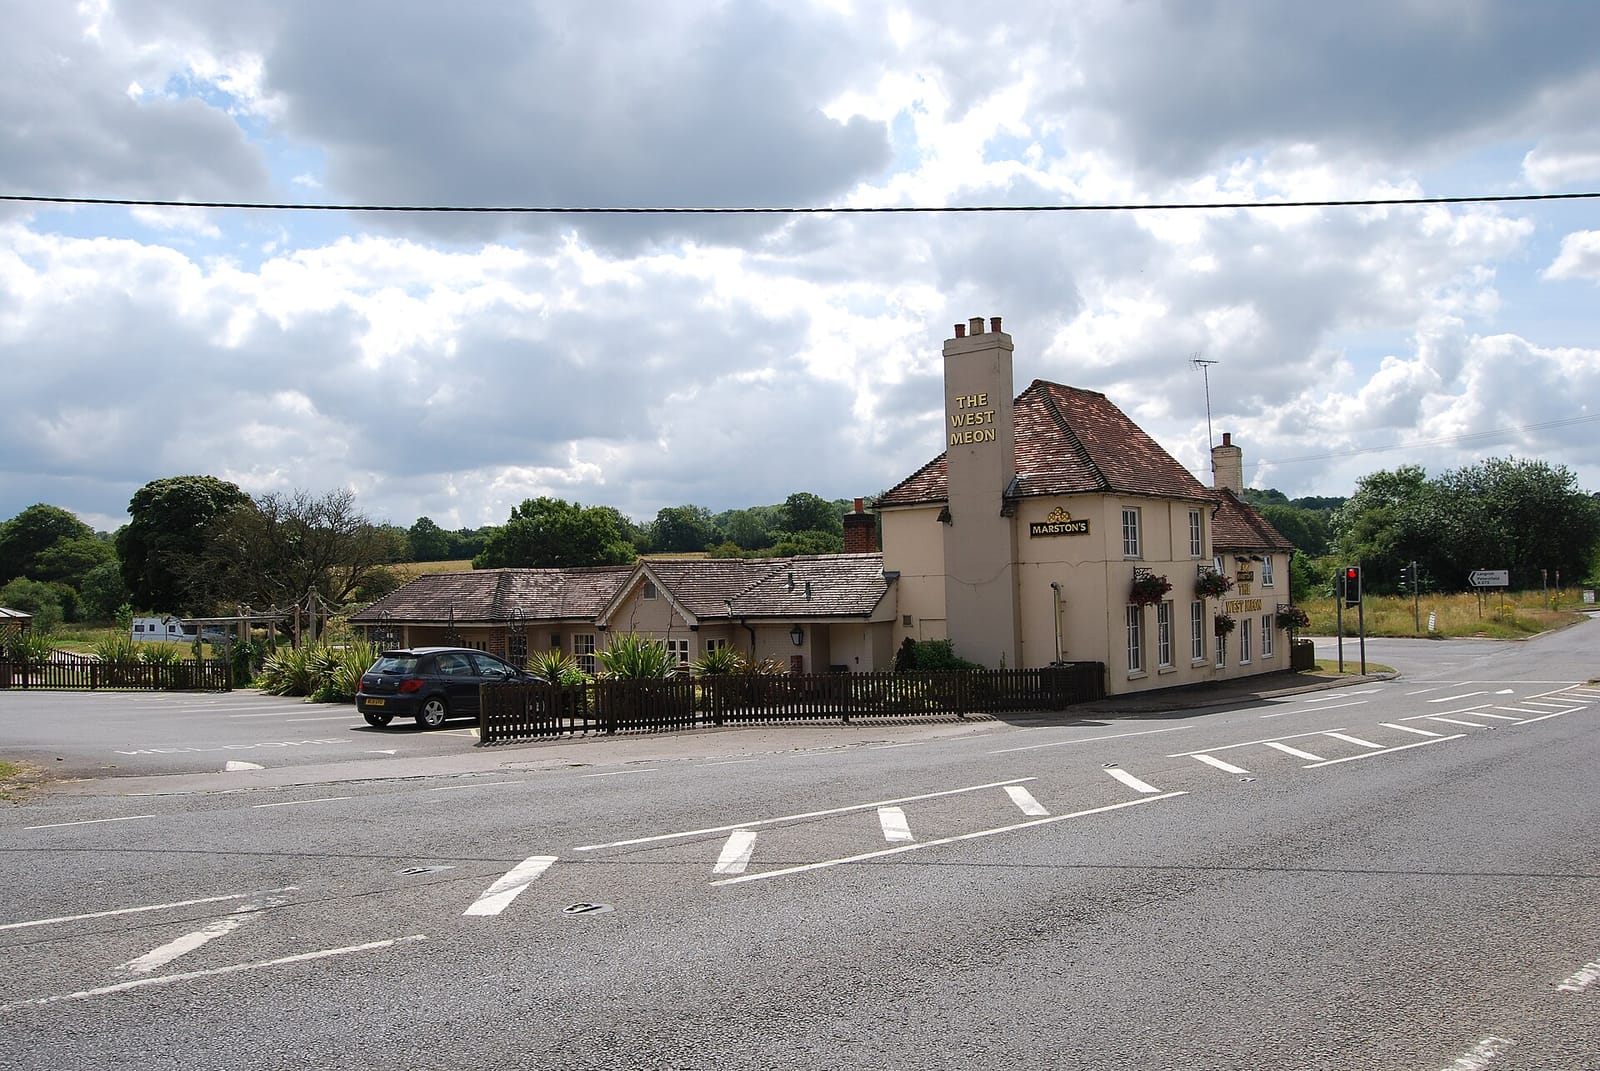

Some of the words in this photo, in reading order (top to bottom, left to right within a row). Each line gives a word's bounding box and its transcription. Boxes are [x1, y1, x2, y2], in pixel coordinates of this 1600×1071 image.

[955, 393, 988, 409] THE
[951, 410, 995, 427] WEST
[950, 428, 996, 446] MEON
[1032, 522, 1087, 534] MARSTON'S
[1226, 600, 1244, 613] WEST
